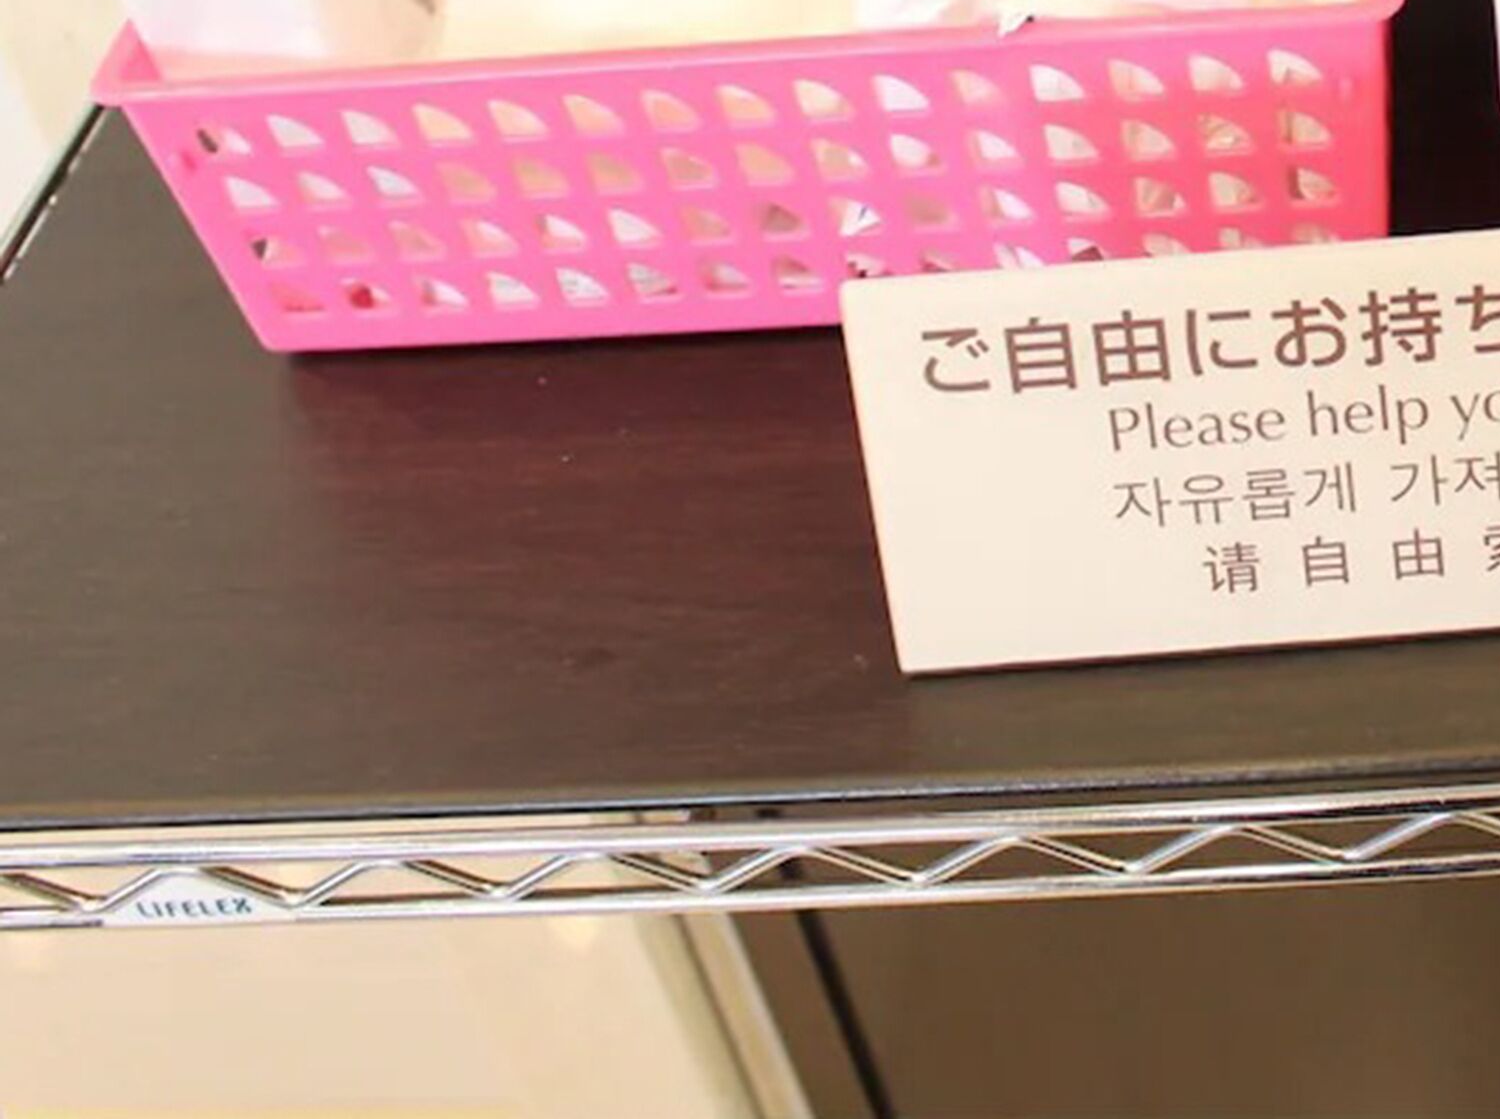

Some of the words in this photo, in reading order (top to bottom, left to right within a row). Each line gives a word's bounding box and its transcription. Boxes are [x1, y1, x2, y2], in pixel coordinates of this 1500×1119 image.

[1107, 401, 1286, 452] Please
[1306, 384, 1430, 445] help
[1112, 460, 1358, 528] 자유롭게
[136, 897, 252, 918] LIFELEX
